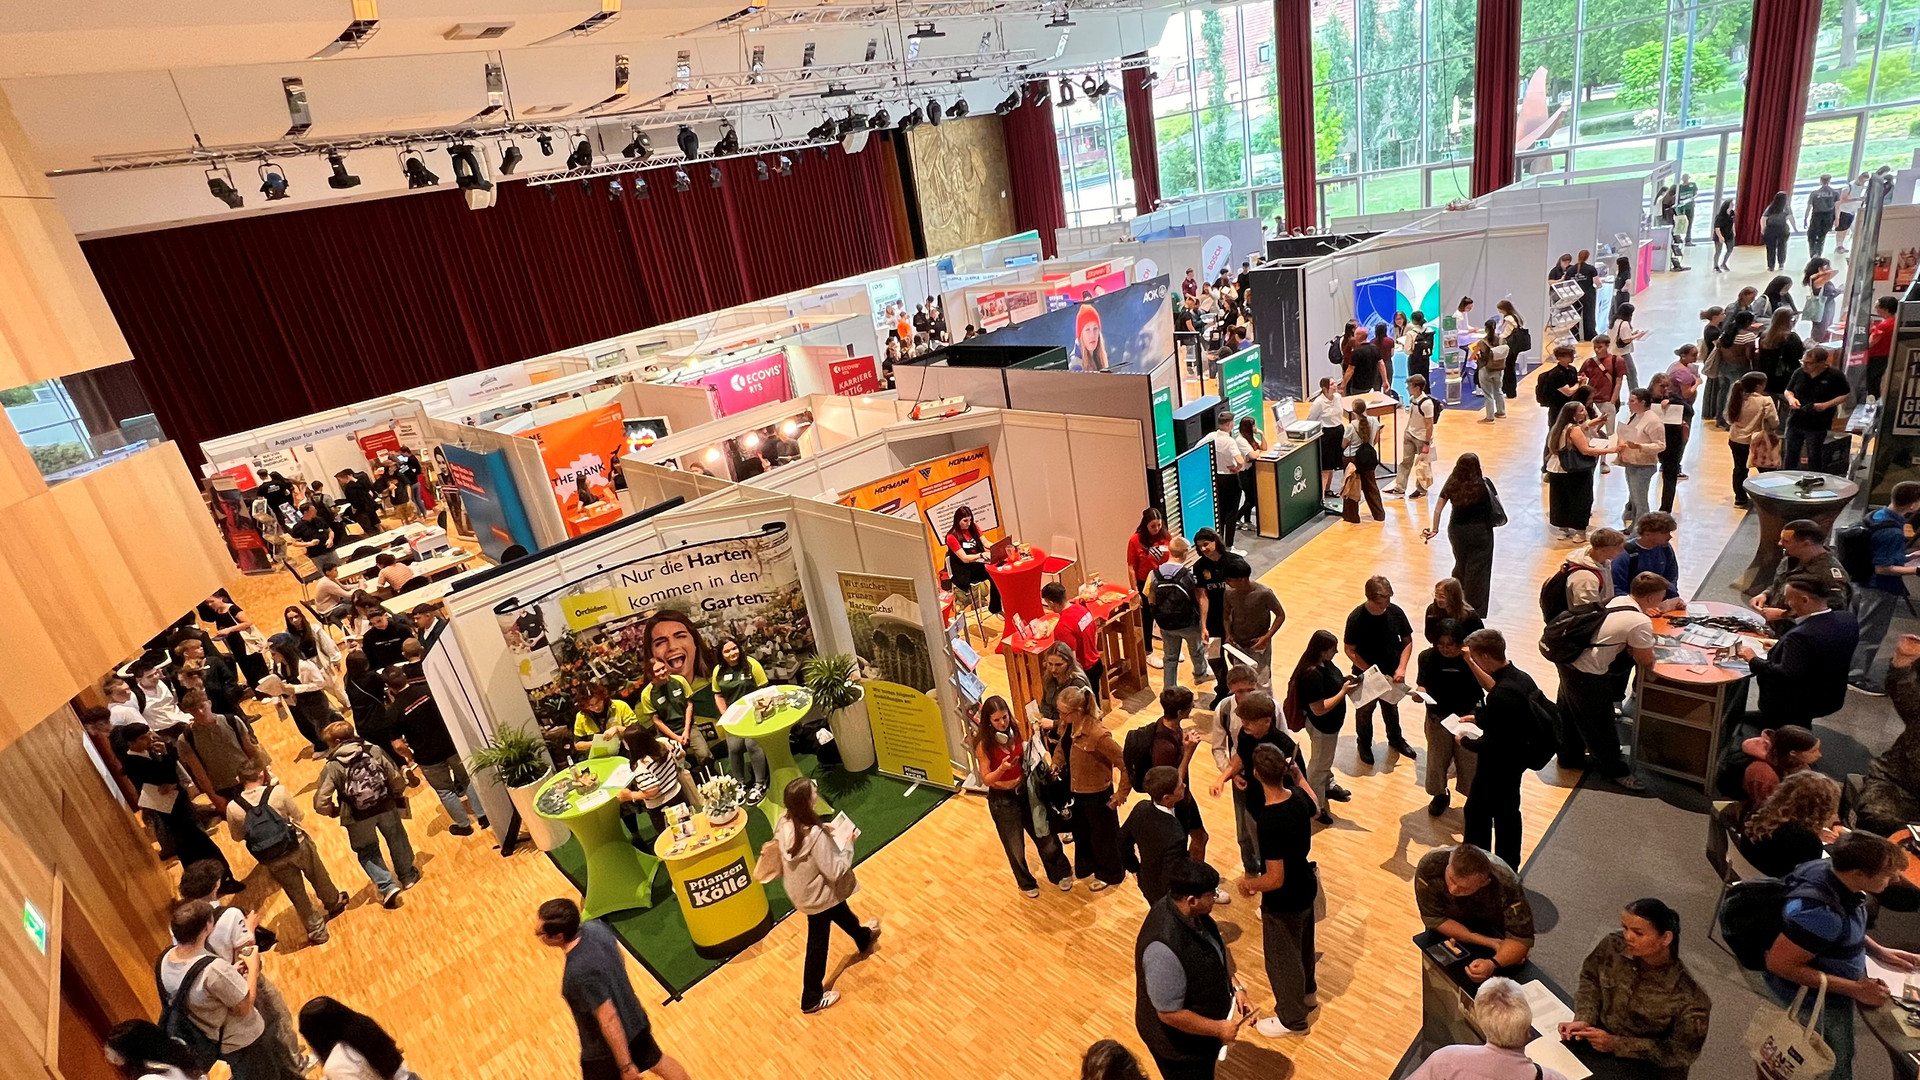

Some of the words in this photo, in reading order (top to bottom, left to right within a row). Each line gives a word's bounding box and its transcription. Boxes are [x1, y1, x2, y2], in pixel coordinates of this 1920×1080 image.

[1207, 246, 1223, 270] BOSCH
[1143, 289, 1159, 303] AOK
[746, 365, 781, 384] ECOVIS
[839, 370, 873, 390] KARRIERE
[749, 383, 763, 394] RTS
[838, 384, 863, 396] ERTIG
[275, 435, 302, 446] Agentur
[303, 431, 313, 439] für
[315, 425, 335, 436] Arbeit
[335, 418, 367, 430] Heilbronn
[948, 451, 985, 467] HOFMANN
[552, 473, 574, 487] THE
[874, 477, 910, 495] HOFMANN
[1291, 478, 1307, 497] AOK
[621, 569, 655, 588] Nur
[660, 561, 684, 576] die
[687, 549, 753, 569] Harten
[628, 581, 703, 610] kommen
[708, 575, 724, 588] in
[730, 570, 759, 584] den
[844, 580, 858, 588] Wir
[860, 581, 887, 591] suchen
[575, 604, 608, 617] Orchideen
[701, 594, 769, 612] Garten.
[849, 601, 894, 613] Nachwuchs!
[689, 863, 743, 891] Pflanzen
[693, 874, 748, 906] Kölle
